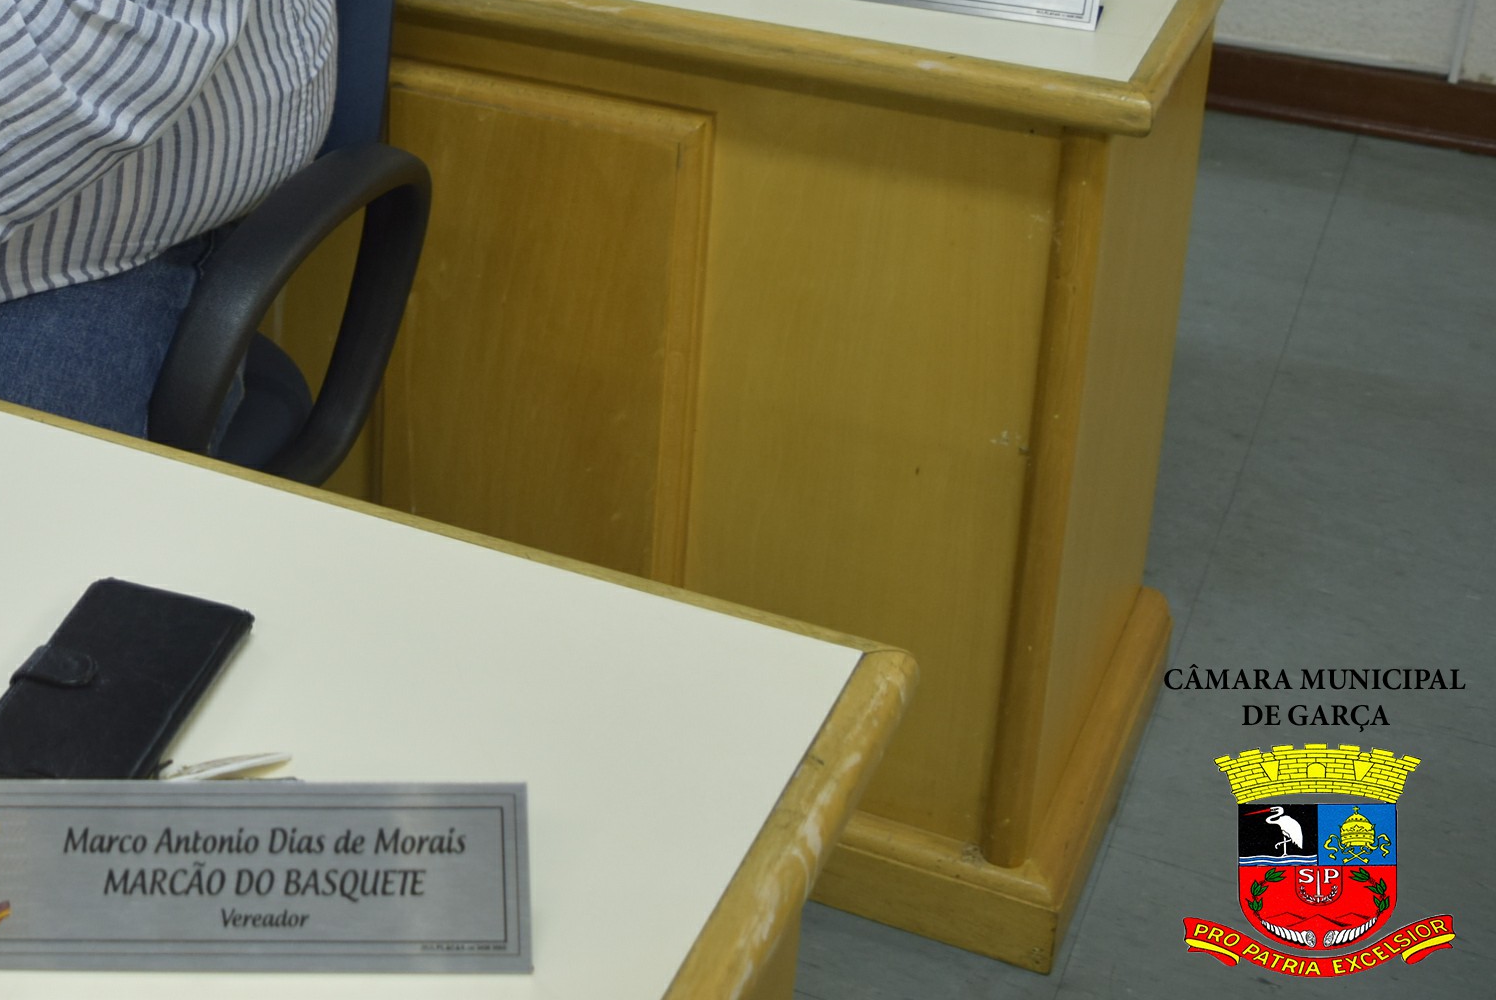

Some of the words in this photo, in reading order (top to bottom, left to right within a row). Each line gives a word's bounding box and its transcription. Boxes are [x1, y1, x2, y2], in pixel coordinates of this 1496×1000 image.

[63, 827, 148, 856] Marco
[153, 827, 261, 856] Antonio
[268, 826, 326, 856] Dias
[331, 826, 366, 856] de
[372, 827, 467, 857] Morais
[102, 861, 230, 897] MARCÃO
[235, 868, 275, 897] DO
[282, 868, 427, 902] BASQUETE
[219, 907, 310, 929] Vereador
